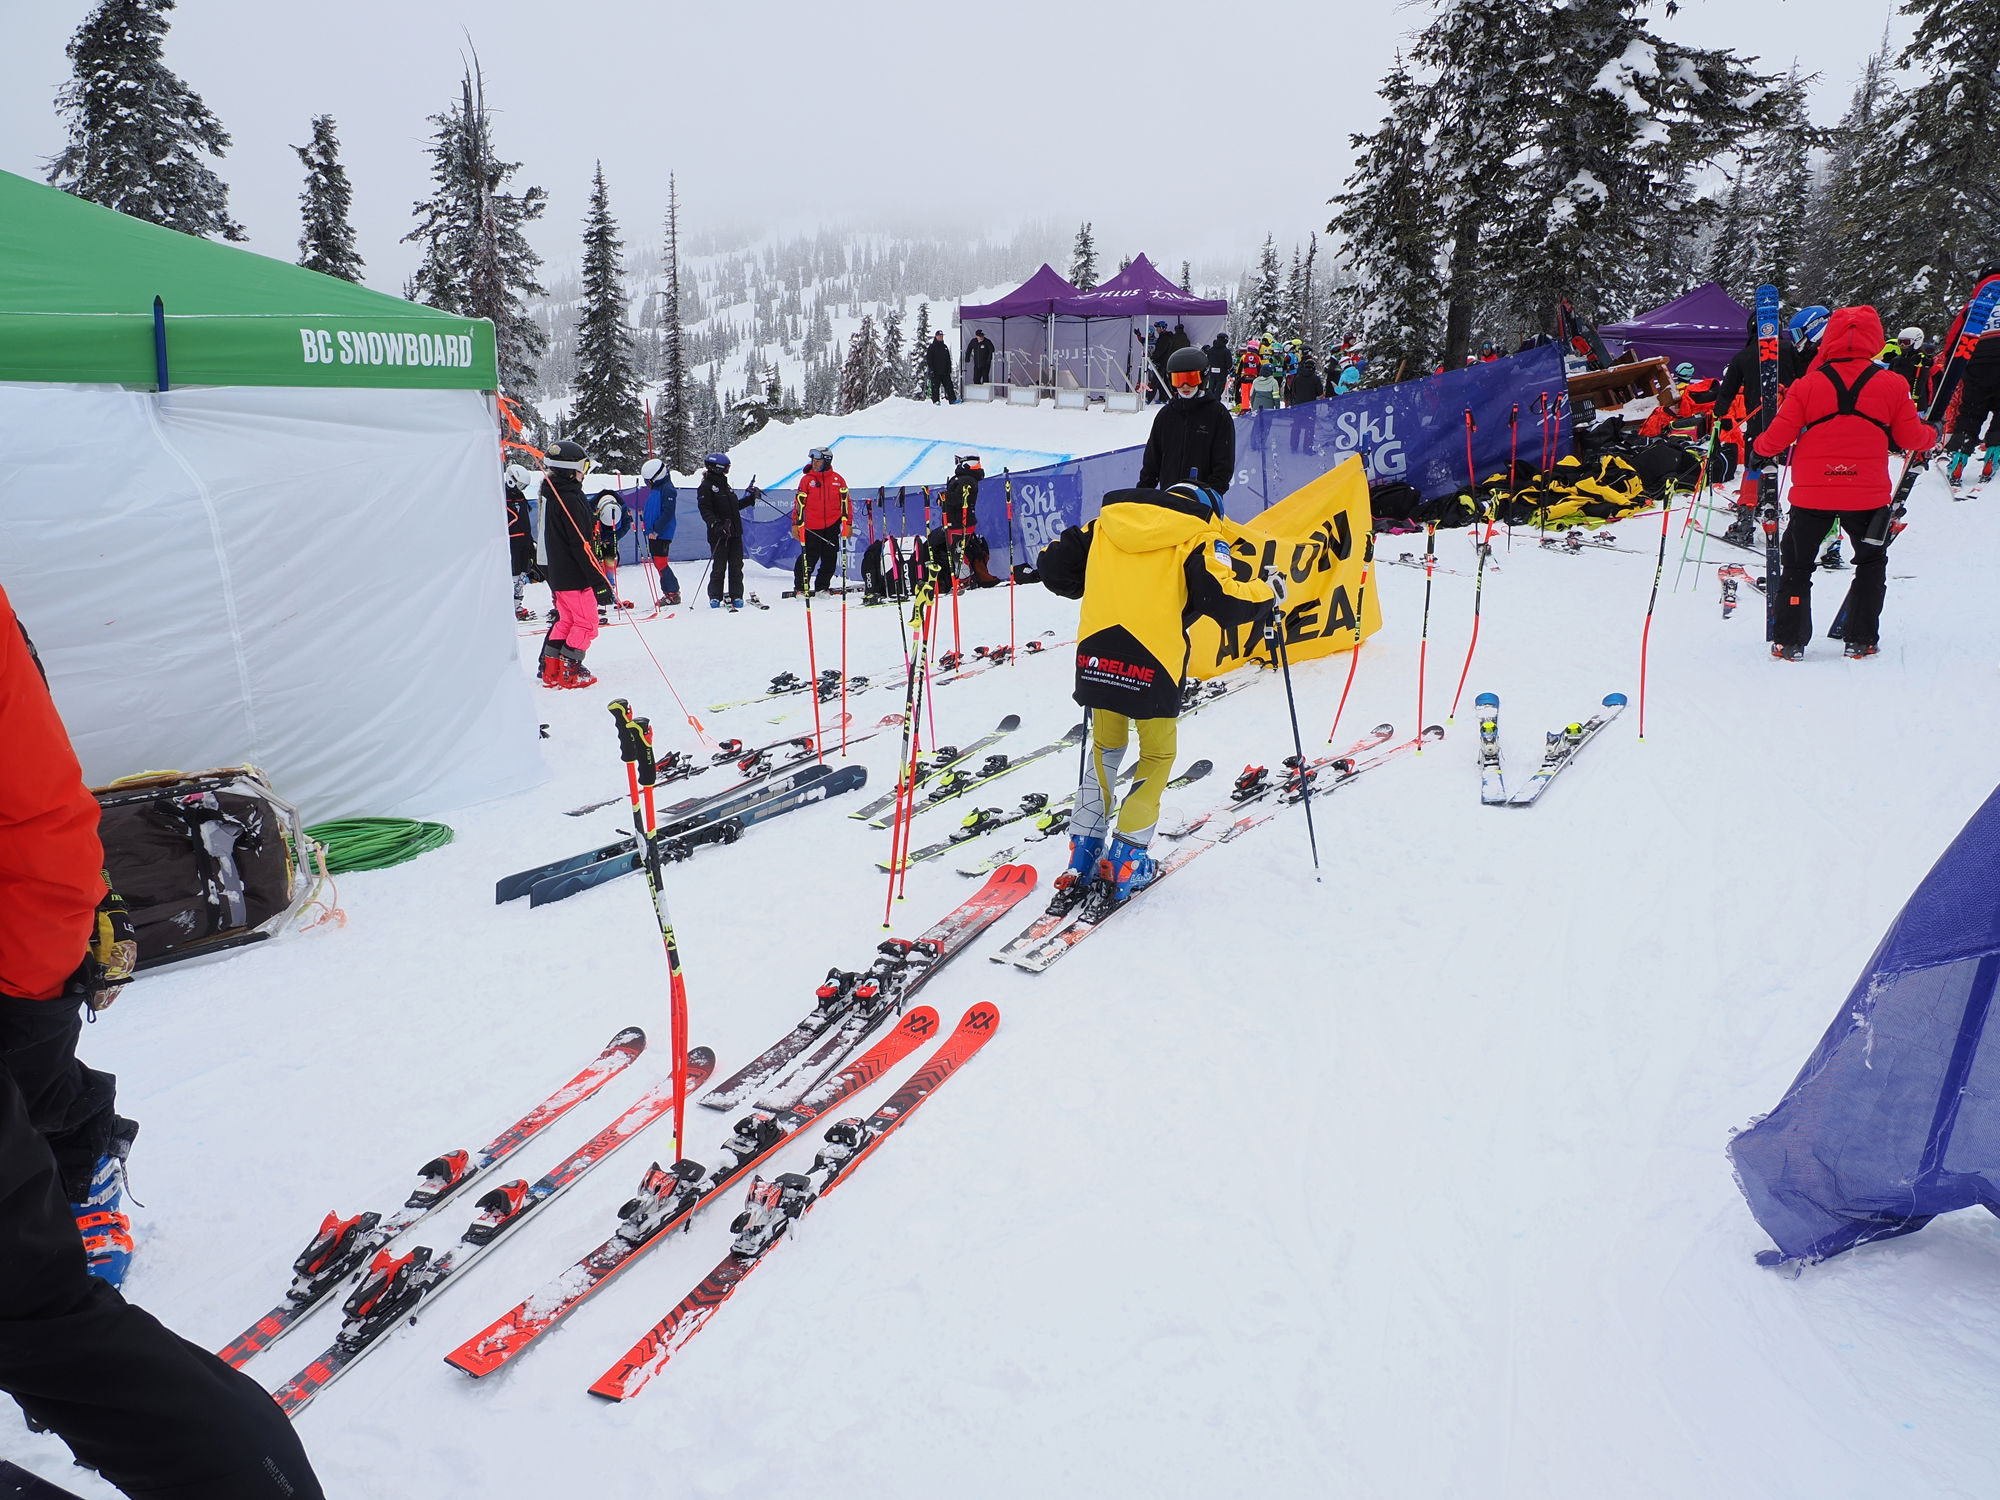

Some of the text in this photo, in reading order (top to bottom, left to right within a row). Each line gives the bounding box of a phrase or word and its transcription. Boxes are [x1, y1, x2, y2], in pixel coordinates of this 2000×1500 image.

[1099, 289, 1140, 298] TELUS
[300, 329, 473, 368] BC SNOWBOARD
[1336, 405, 1396, 450] Ski
[1021, 482, 1056, 516] Ski
[1021, 512, 1067, 547] BIG
[904, 563, 912, 595] HEAD
[1077, 655, 1155, 683] SHORELINE
[904, 701, 913, 735] LEKI
[793, 1104, 818, 1118] GS
